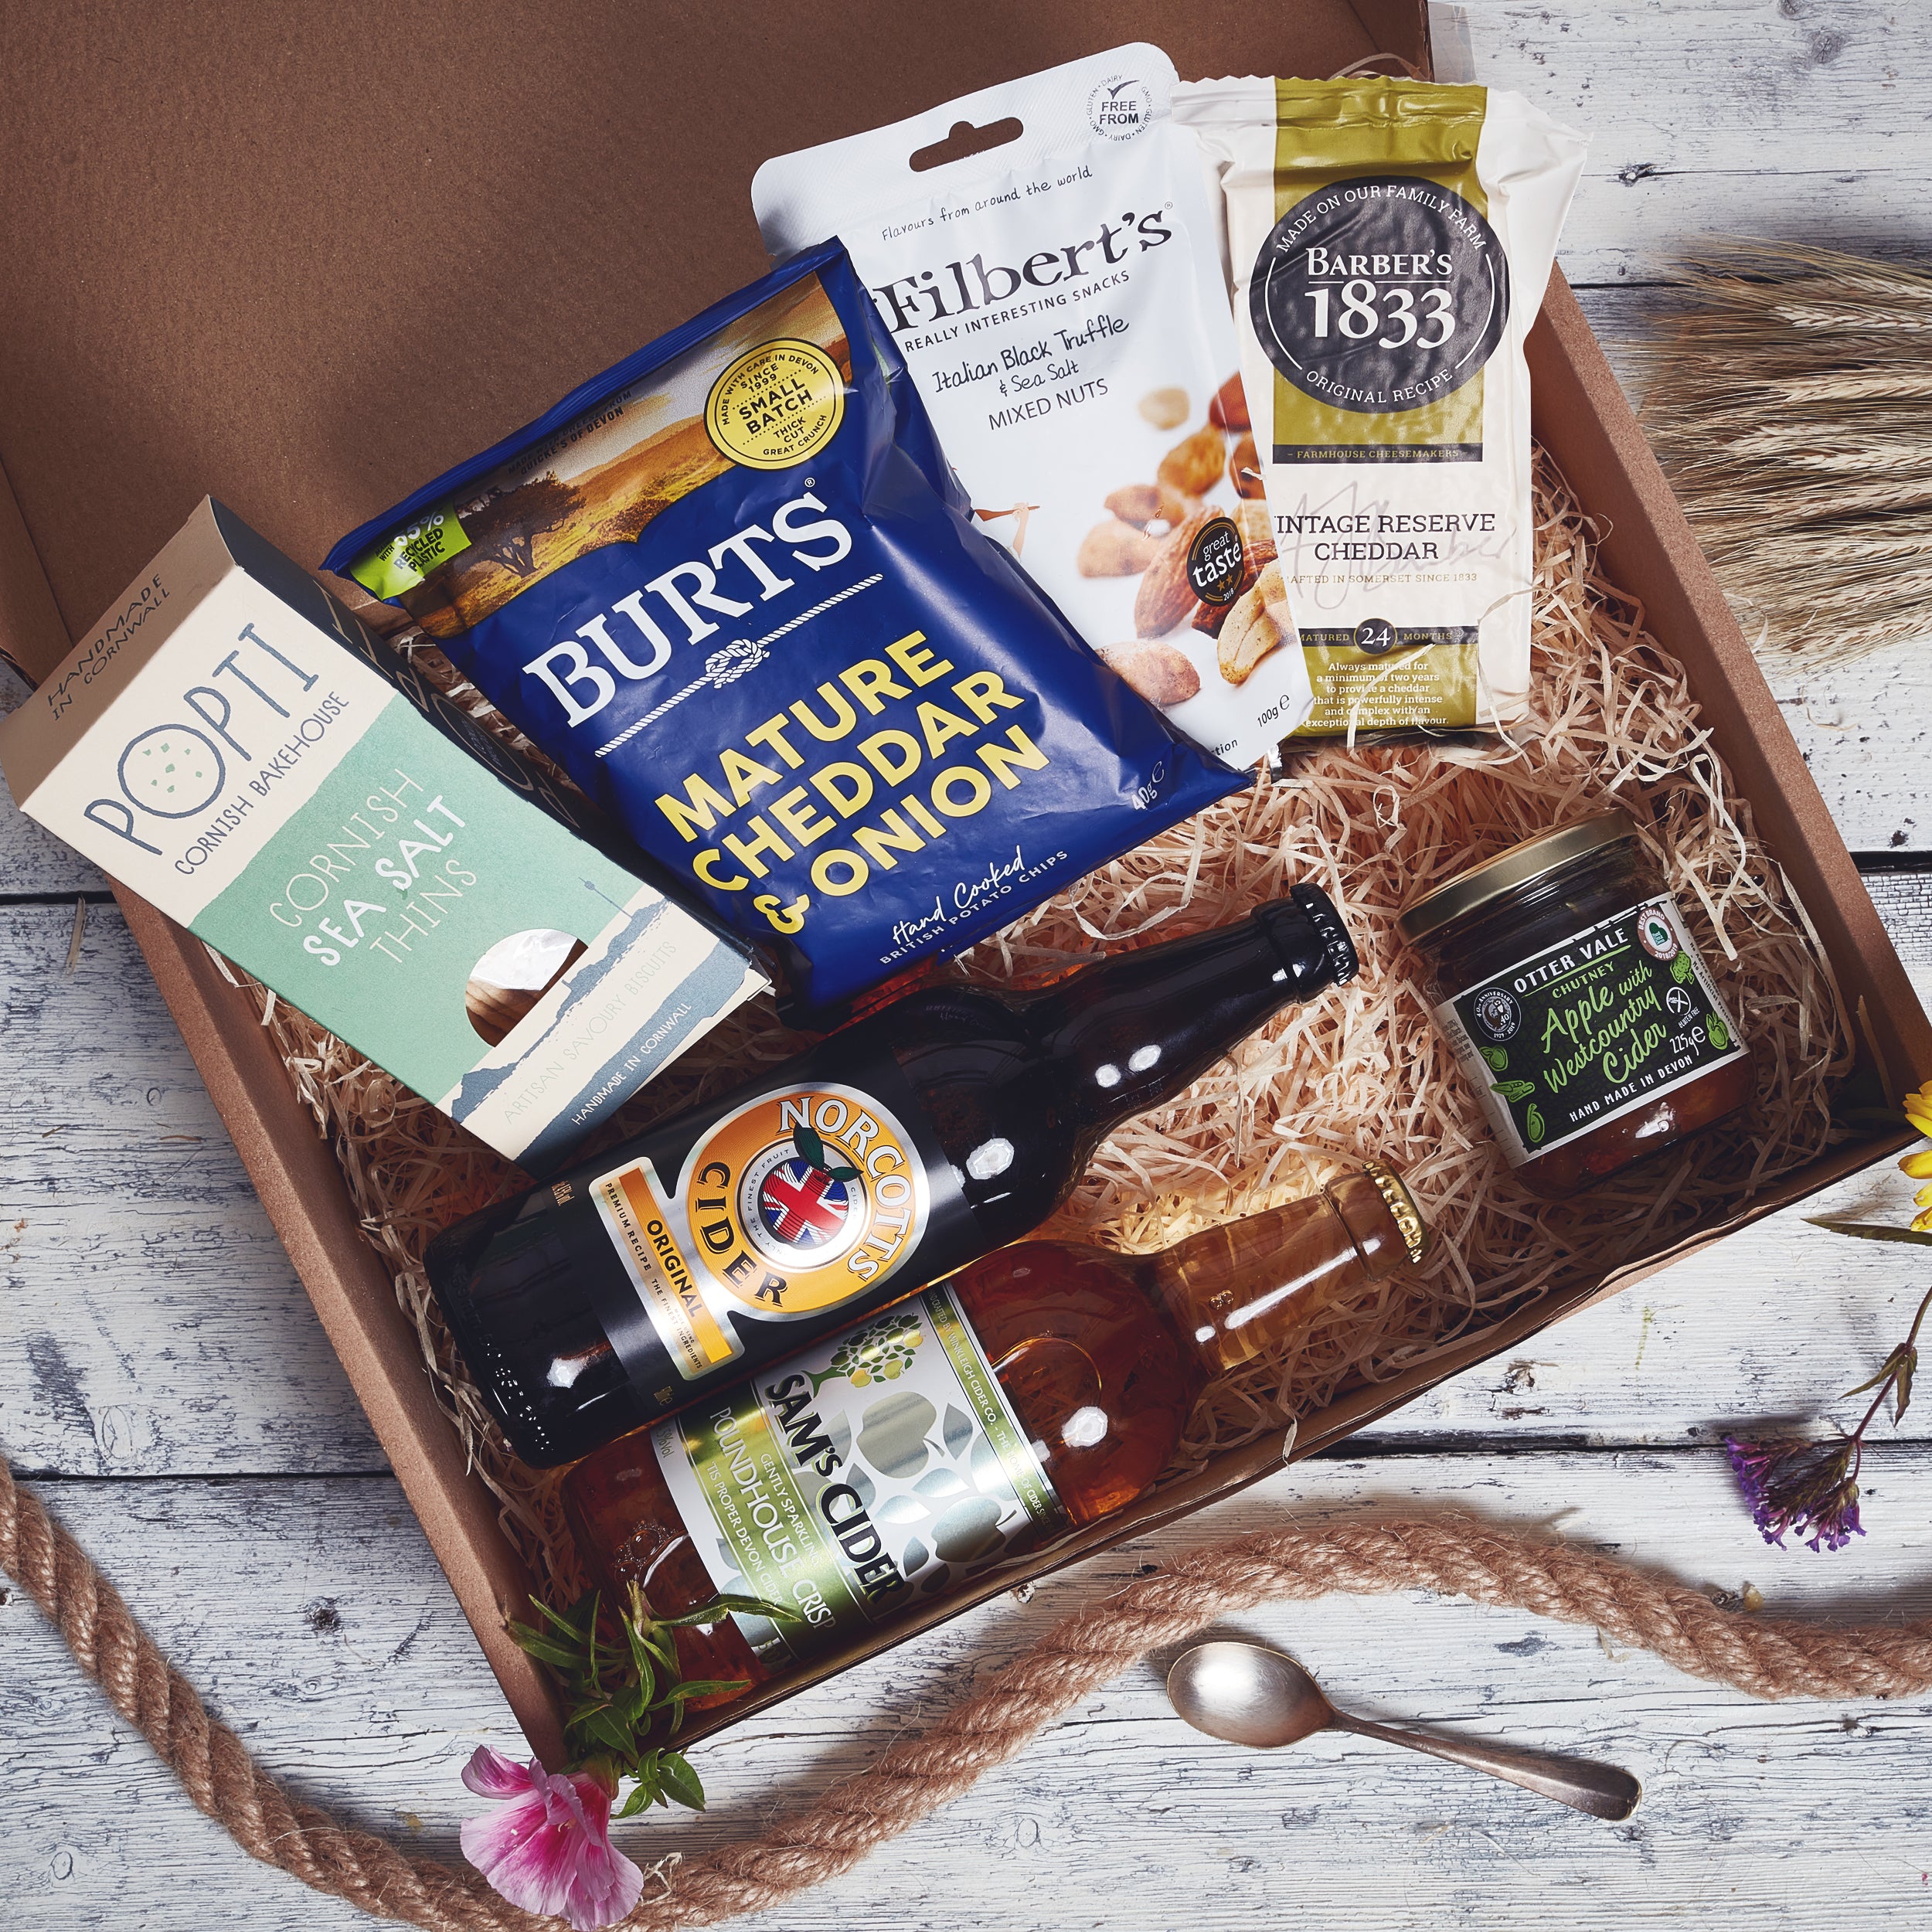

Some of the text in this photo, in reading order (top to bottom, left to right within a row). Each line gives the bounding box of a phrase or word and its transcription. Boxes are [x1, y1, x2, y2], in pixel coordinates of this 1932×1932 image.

[1086, 88, 1099, 116] GLUTEN
[1099, 113, 1139, 124] FROM
[1101, 100, 1137, 112] FREE
[1135, 109, 1152, 134] GLUTEN
[1090, 120, 1104, 136] GMO
[1108, 132, 1131, 141] DAIRY
[882, 165, 1093, 240] Flavours from around the world
[1277, 185, 1488, 253] MADE ON OUR FAMILY FARM
[872, 210, 1173, 334] Filbert's
[905, 270, 1131, 352] REALLY INTERESTING SNACKS
[1304, 278, 1456, 349] 1833
[740, 363, 779, 389] SINCE
[746, 356, 772, 372] CARE
[788, 355, 819, 375] DEVON
[932, 314, 1130, 393] Italian Black Truffle
[725, 372, 745, 396] WITH
[739, 378, 805, 421] SMALL
[748, 374, 777, 393] 1999
[998, 359, 1080, 397] & Sea Salt
[1306, 368, 1454, 404] ORIGINAL RECIPE
[570, 429, 583, 442] OF
[587, 406, 624, 434] DEVON
[721, 399, 730, 426] MADE
[746, 389, 813, 434] BATCH
[988, 377, 1109, 430] MIXED NUTS
[763, 414, 827, 456] GREAT CRUNCH
[773, 417, 806, 439] THICK
[784, 427, 805, 443] CUT
[1297, 448, 1459, 459] FARMHOUSE CHEESEMAKERS
[1274, 513, 1496, 534] INTAGE RESERVE
[393, 528, 444, 570] RECYCLED
[407, 541, 445, 573] PLASTIC
[1192, 543, 1241, 587] taste
[1203, 531, 1230, 562] great
[1315, 542, 1440, 562] CHEDDAR
[1332, 572, 1478, 584] IN SOMERSET SINCE 1833
[522, 492, 852, 728] BURTS
[47, 573, 163, 707] HANDMADE
[51, 587, 171, 721] IN CORNWALL
[1361, 627, 1391, 648] 24
[1403, 631, 1453, 641] MONTHS
[1325, 673, 1375, 682] minimum
[1412, 674, 1440, 683] years
[1328, 662, 1429, 672] Always for
[1388, 683, 1430, 693] cheddar
[1257, 706, 1278, 727] 100g
[1313, 695, 1443, 705] that is intense
[1325, 706, 1344, 716] and
[1392, 706, 1416, 714] with
[1367, 716, 1396, 726] depth
[1399, 716, 1409, 725] of
[83, 623, 319, 856] POPTI
[655, 630, 954, 842] MATURE
[175, 691, 350, 876] CORNISH BAKEHOUSE
[692, 671, 1025, 892] CHEDDAR
[270, 768, 424, 928] CORNISH
[753, 724, 1050, 934] & ONION
[303, 794, 466, 967] SEA SALT
[893, 845, 1025, 945] Hand Cooked
[369, 859, 478, 964] THINS
[879, 851, 1068, 965] BRITISH POTATO CHIPS
[1638, 909, 1665, 930] BEST BRAND
[1513, 927, 1629, 994] OTTER VALE
[1551, 961, 1616, 1000] CHUTNEY
[1478, 991, 1513, 1005] ANNIVERSARY
[1539, 959, 1653, 1054] Apple with
[1691, 1006, 1700, 1017] FREE
[503, 940, 677, 1124] ARTISAN SAVOURY BISCUITS
[1543, 985, 1662, 1094] Westcountry
[1602, 1021, 1667, 1083] Cider
[571, 1003, 692, 1126] HANDMADE IN CORNWALL
[1569, 1054, 1693, 1122] HAND MADE IN DEVON
[747, 1148, 790, 1237] THE FINEST FRUIT
[777, 1097, 912, 1281] NORCOTTS
[605, 1182, 651, 1271] PREMIUM RECIPE
[696, 1162, 787, 1307] CIDER
[647, 1219, 702, 1318] ORIGINAL
[651, 1278, 662, 1296] THE
[676, 1328, 702, 1369] INGREDIENTS
[943, 1322, 998, 1426] BY WINKLEIGH CIDER CO.
[997, 1430, 1043, 1511] THE CIDER
[709, 1406, 804, 1578] POUNDHOUSE
[792, 1579, 837, 1629] CRISP
[760, 1453, 823, 1566] GENTLY SPARKLING
[714, 1481, 743, 1529] PROPER
[736, 1527, 766, 1573] DEVON
[760, 1571, 784, 1606] CIDER
[817, 1482, 905, 1604] CIDER
